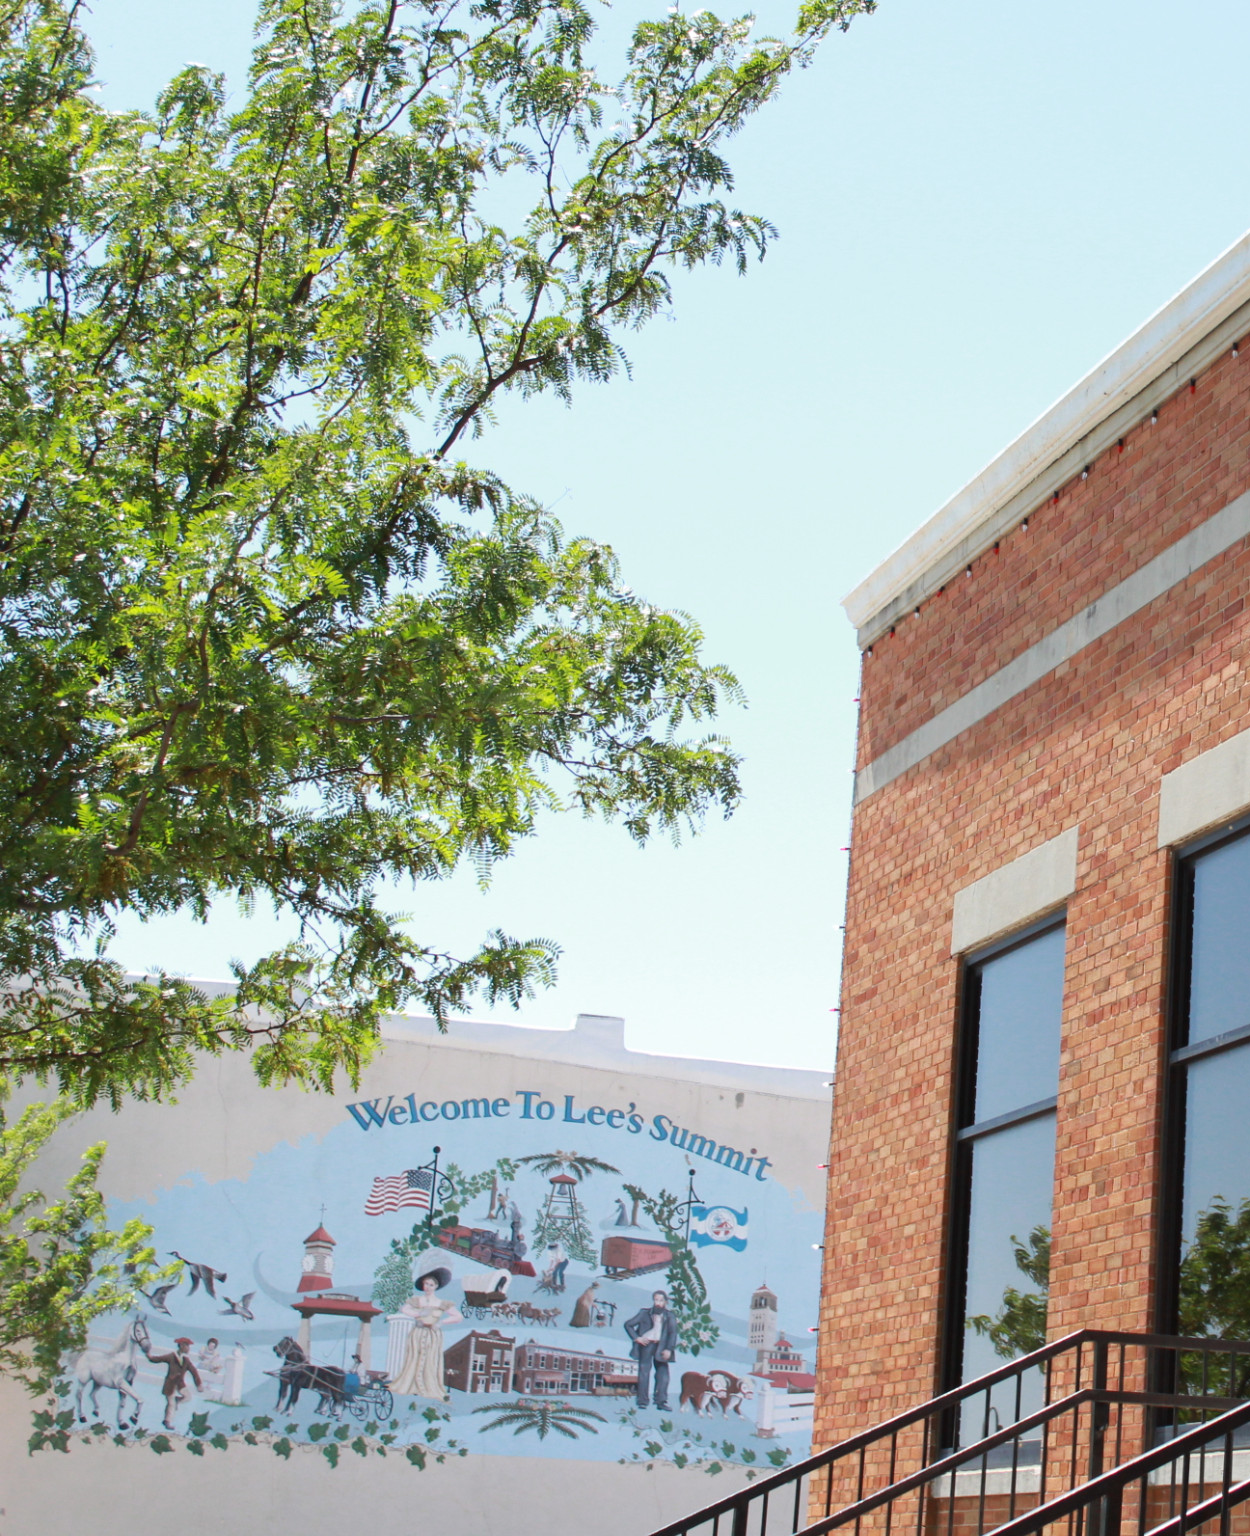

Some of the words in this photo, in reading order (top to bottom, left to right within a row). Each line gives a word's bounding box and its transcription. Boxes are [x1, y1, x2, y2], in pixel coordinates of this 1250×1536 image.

[345, 1092, 511, 1131] Welcome
[516, 1091, 556, 1121] To
[562, 1095, 644, 1134] Lee's
[649, 1114, 773, 1182] Summit
